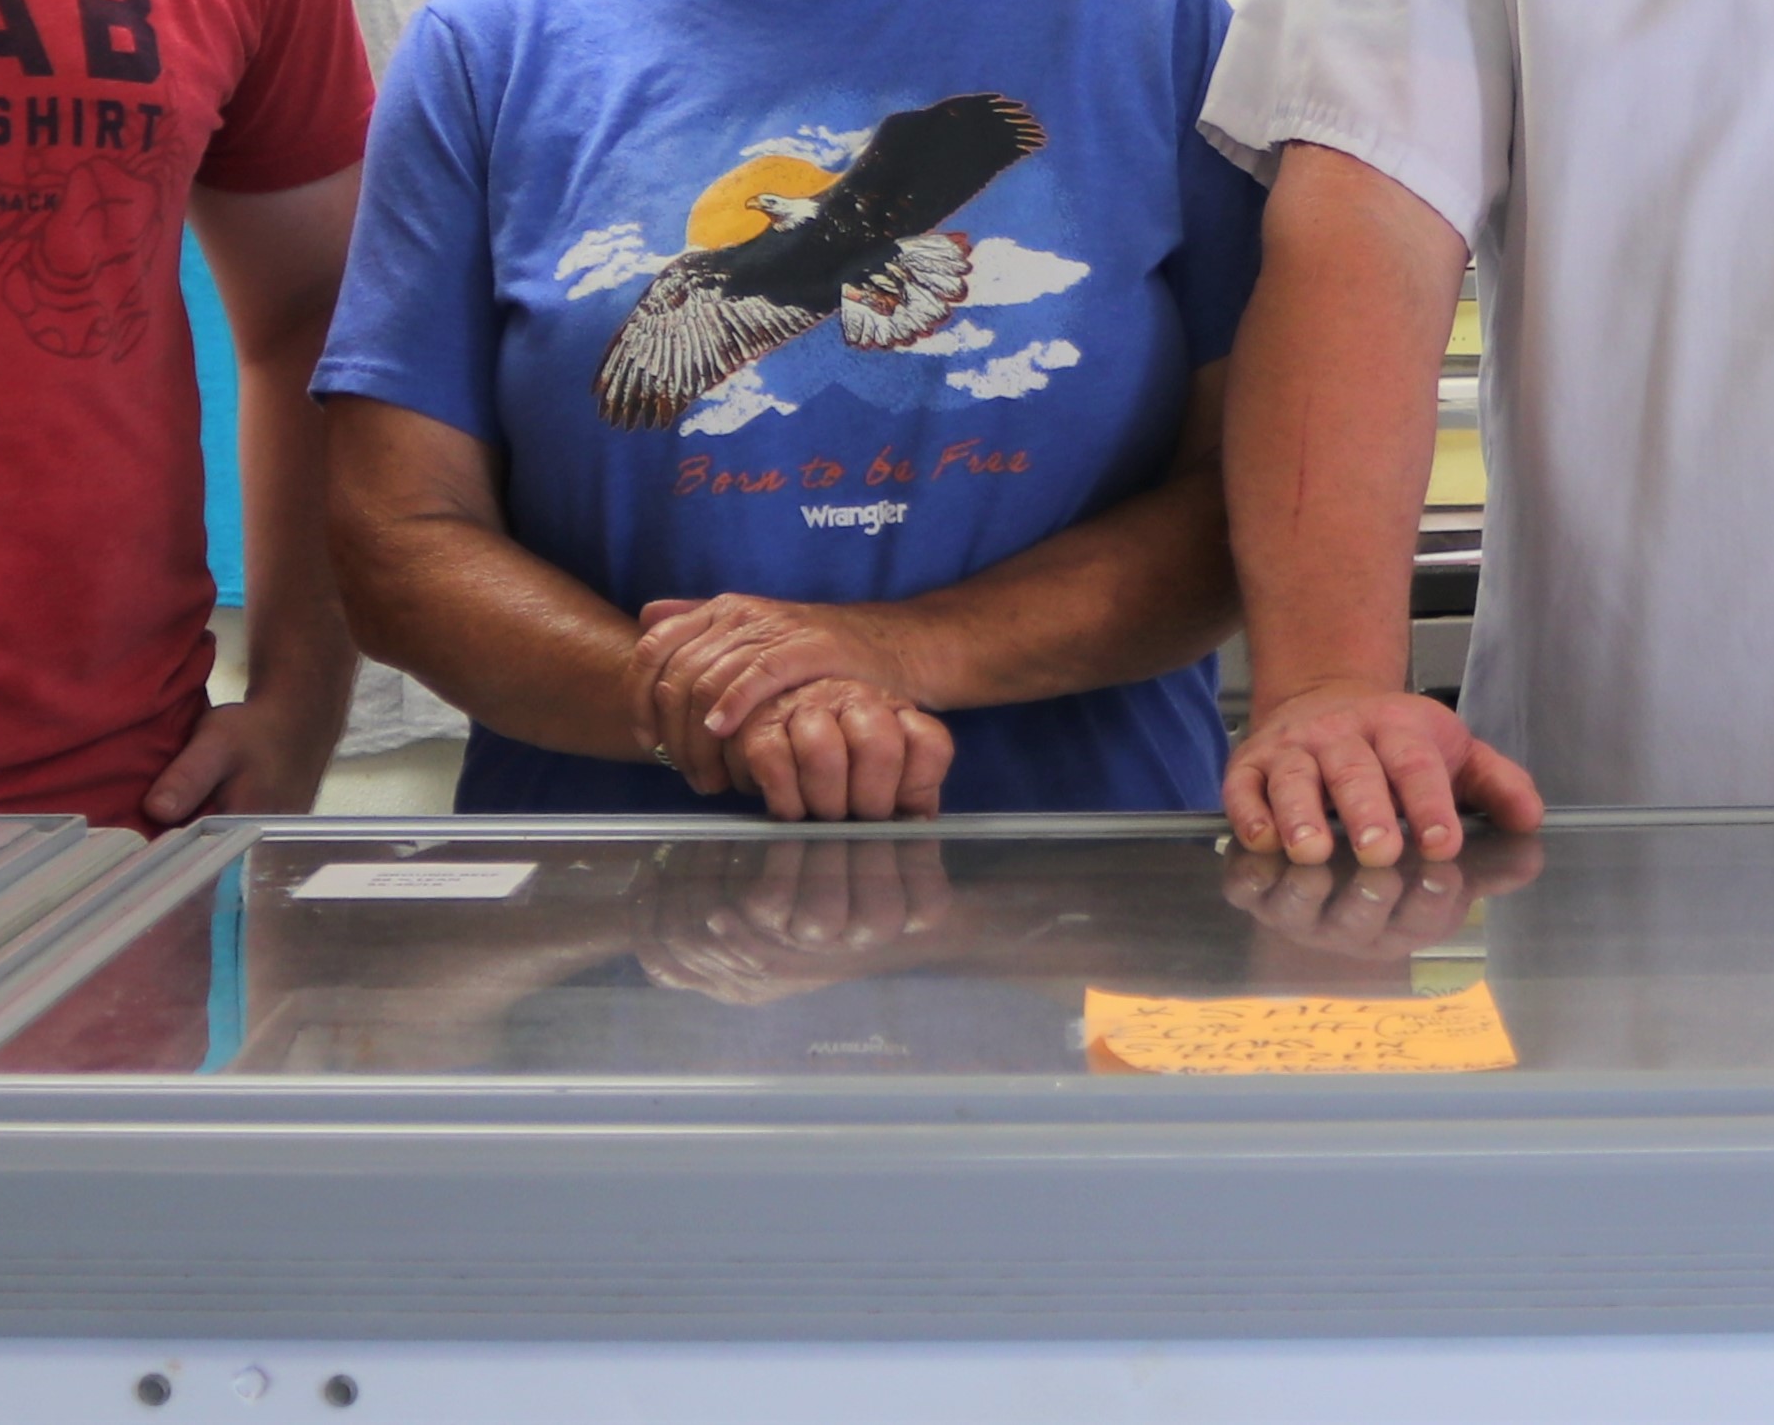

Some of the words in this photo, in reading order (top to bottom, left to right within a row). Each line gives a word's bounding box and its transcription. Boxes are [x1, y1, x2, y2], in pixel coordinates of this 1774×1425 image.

[673, 453, 788, 496] Born
[800, 455, 846, 489] to
[865, 445, 917, 487] be
[931, 438, 1032, 482] Free
[800, 499, 909, 536] Wrangler
